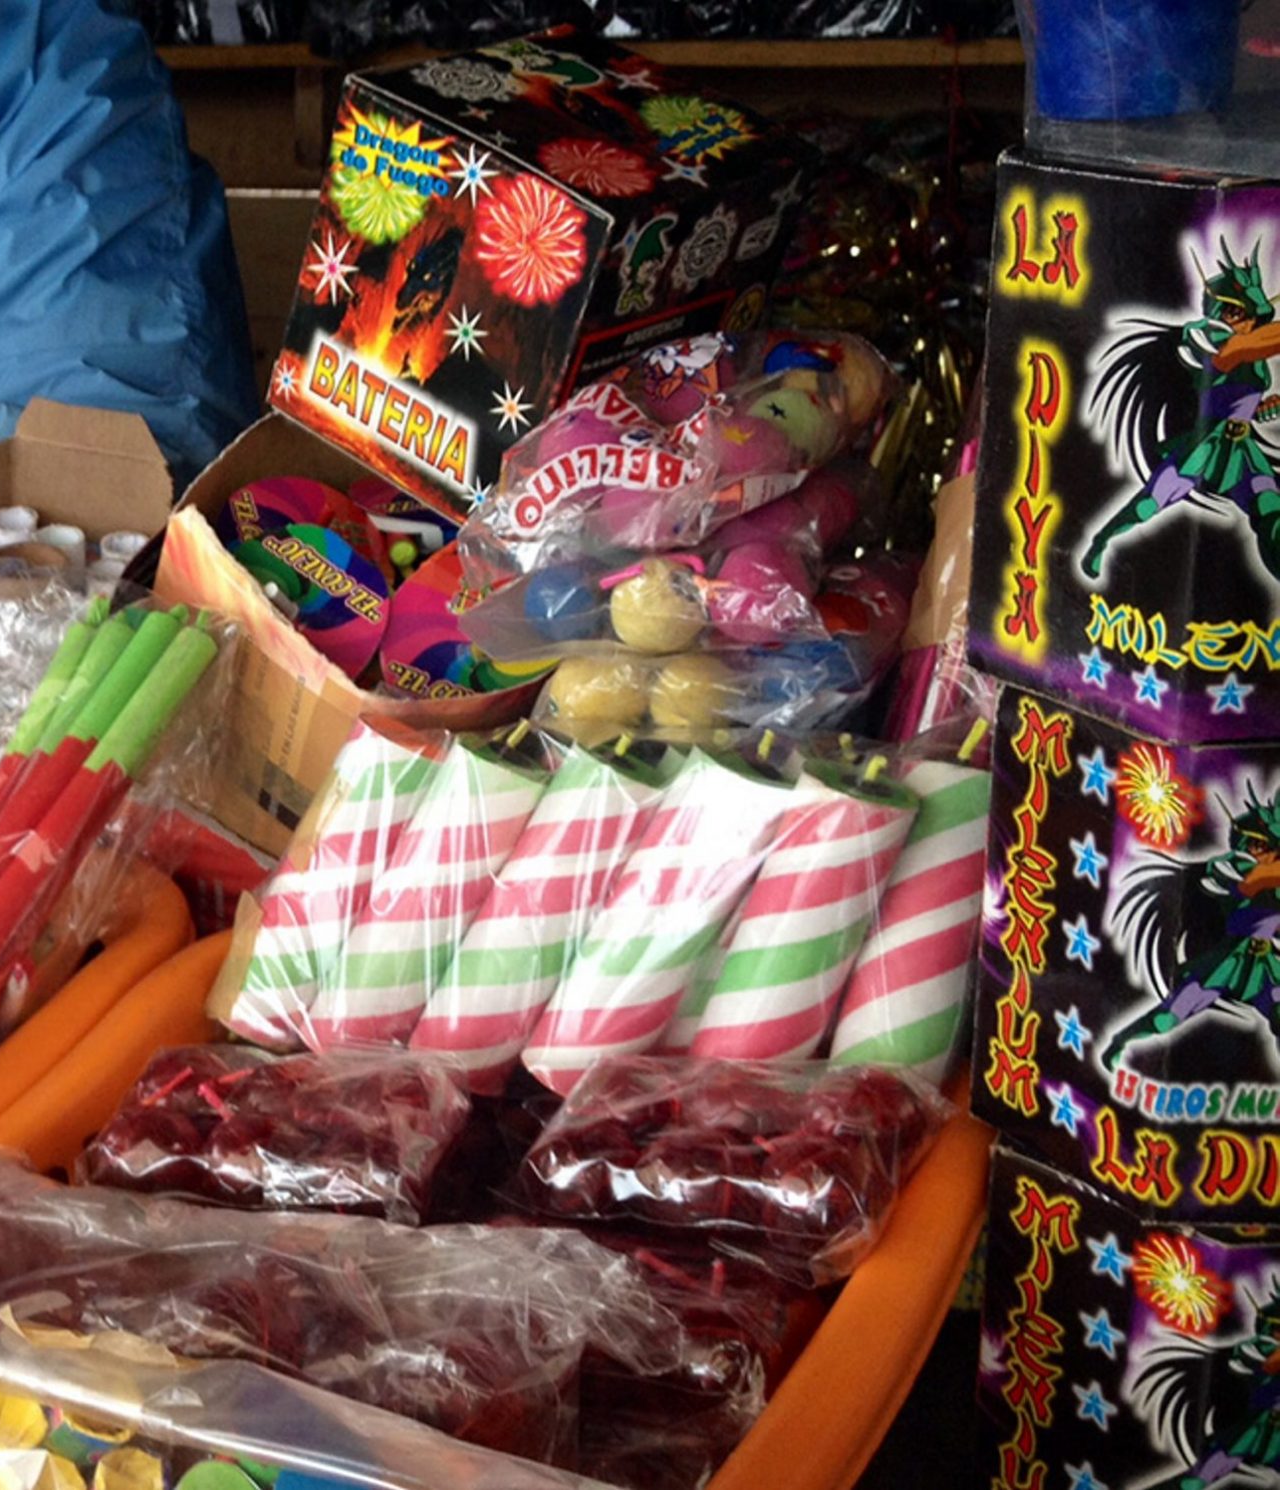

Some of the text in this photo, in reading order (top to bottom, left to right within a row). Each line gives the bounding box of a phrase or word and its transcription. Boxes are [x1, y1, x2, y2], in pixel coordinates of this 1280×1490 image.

[340, 147, 450, 197] de Fuego
[355, 123, 440, 167] Dragon
[1003, 200, 1084, 295] LA
[310, 342, 470, 485] BATERIA
[986, 698, 1074, 1116] MILENIUM
[1143, 1082, 1225, 1119] TIROS
[1230, 1083, 1280, 1119] MU
[1091, 1107, 1181, 1207] LA
[1002, 1177, 1081, 1490] MILENIU
